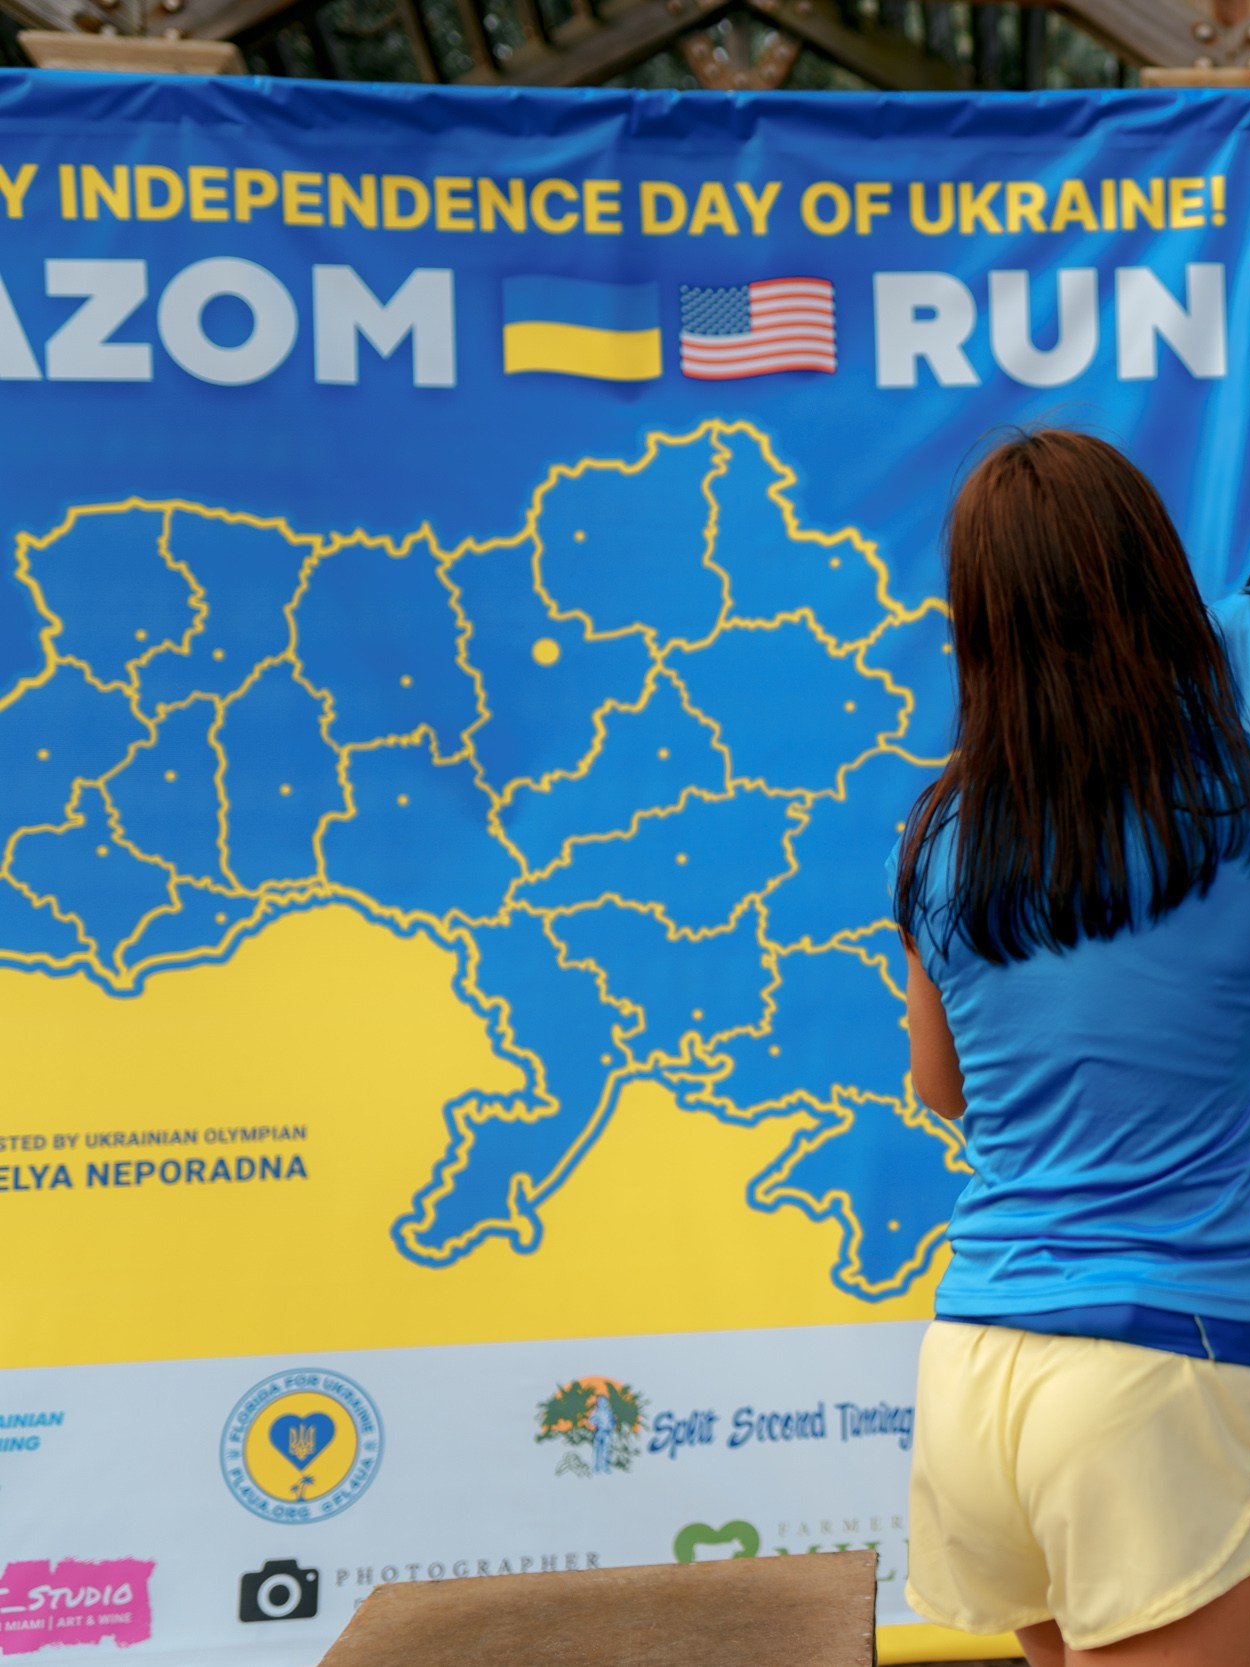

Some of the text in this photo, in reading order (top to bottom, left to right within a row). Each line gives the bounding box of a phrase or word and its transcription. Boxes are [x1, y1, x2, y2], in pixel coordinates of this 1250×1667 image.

[59, 164, 623, 235] INDEPENDENCE
[640, 180, 782, 236] DAY
[801, 181, 892, 236] OF
[909, 175, 1227, 235] UKRAINE!
[872, 262, 1227, 389] RUN
[53, 1131, 79, 1150] BY
[85, 1128, 198, 1149] UKRAINIAN
[204, 1125, 307, 1145] OLYMPIAN
[86, 1153, 308, 1187] NEPORADNA
[229, 1375, 374, 1442] FLORIDA FOR UKRAINE
[647, 1400, 915, 1460] Split Second Timing
[335, 1551, 601, 1587] PHOTOGRAPHER
[5, 1619, 45, 1631] MIAMI
[56, 1615, 83, 1628] ART
